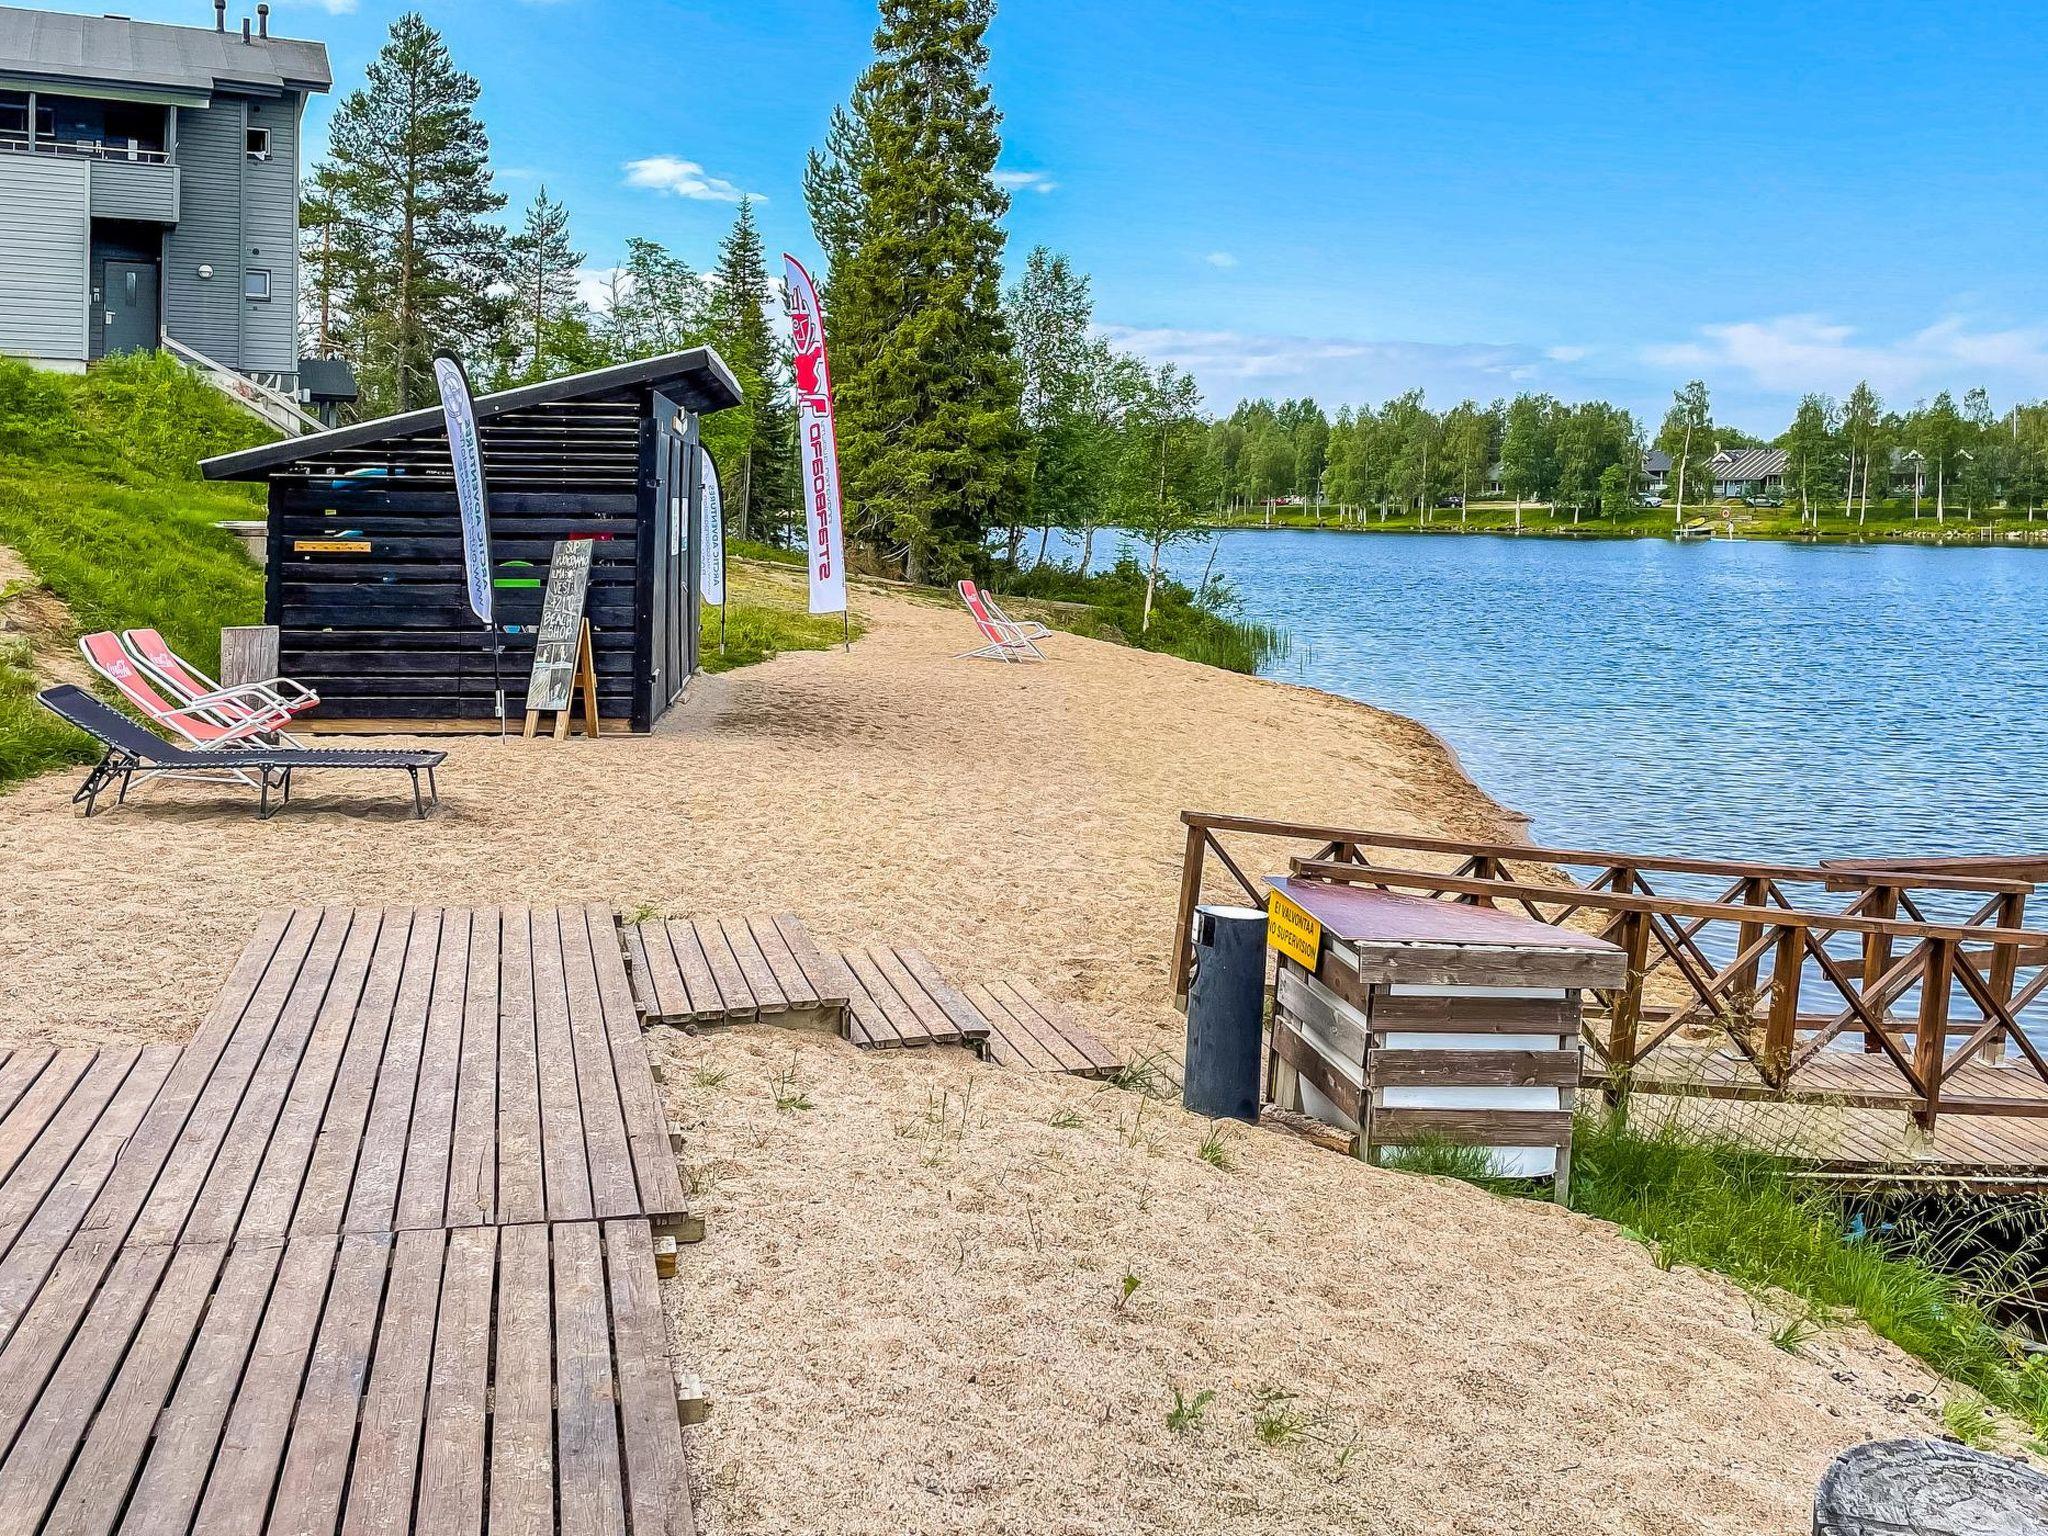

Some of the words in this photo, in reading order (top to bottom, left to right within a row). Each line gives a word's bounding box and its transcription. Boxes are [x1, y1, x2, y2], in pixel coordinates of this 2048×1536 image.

[543, 611, 574, 627] BEACH
[547, 625, 573, 639] SHOP
[1281, 905, 1314, 935] VALVONTAA
